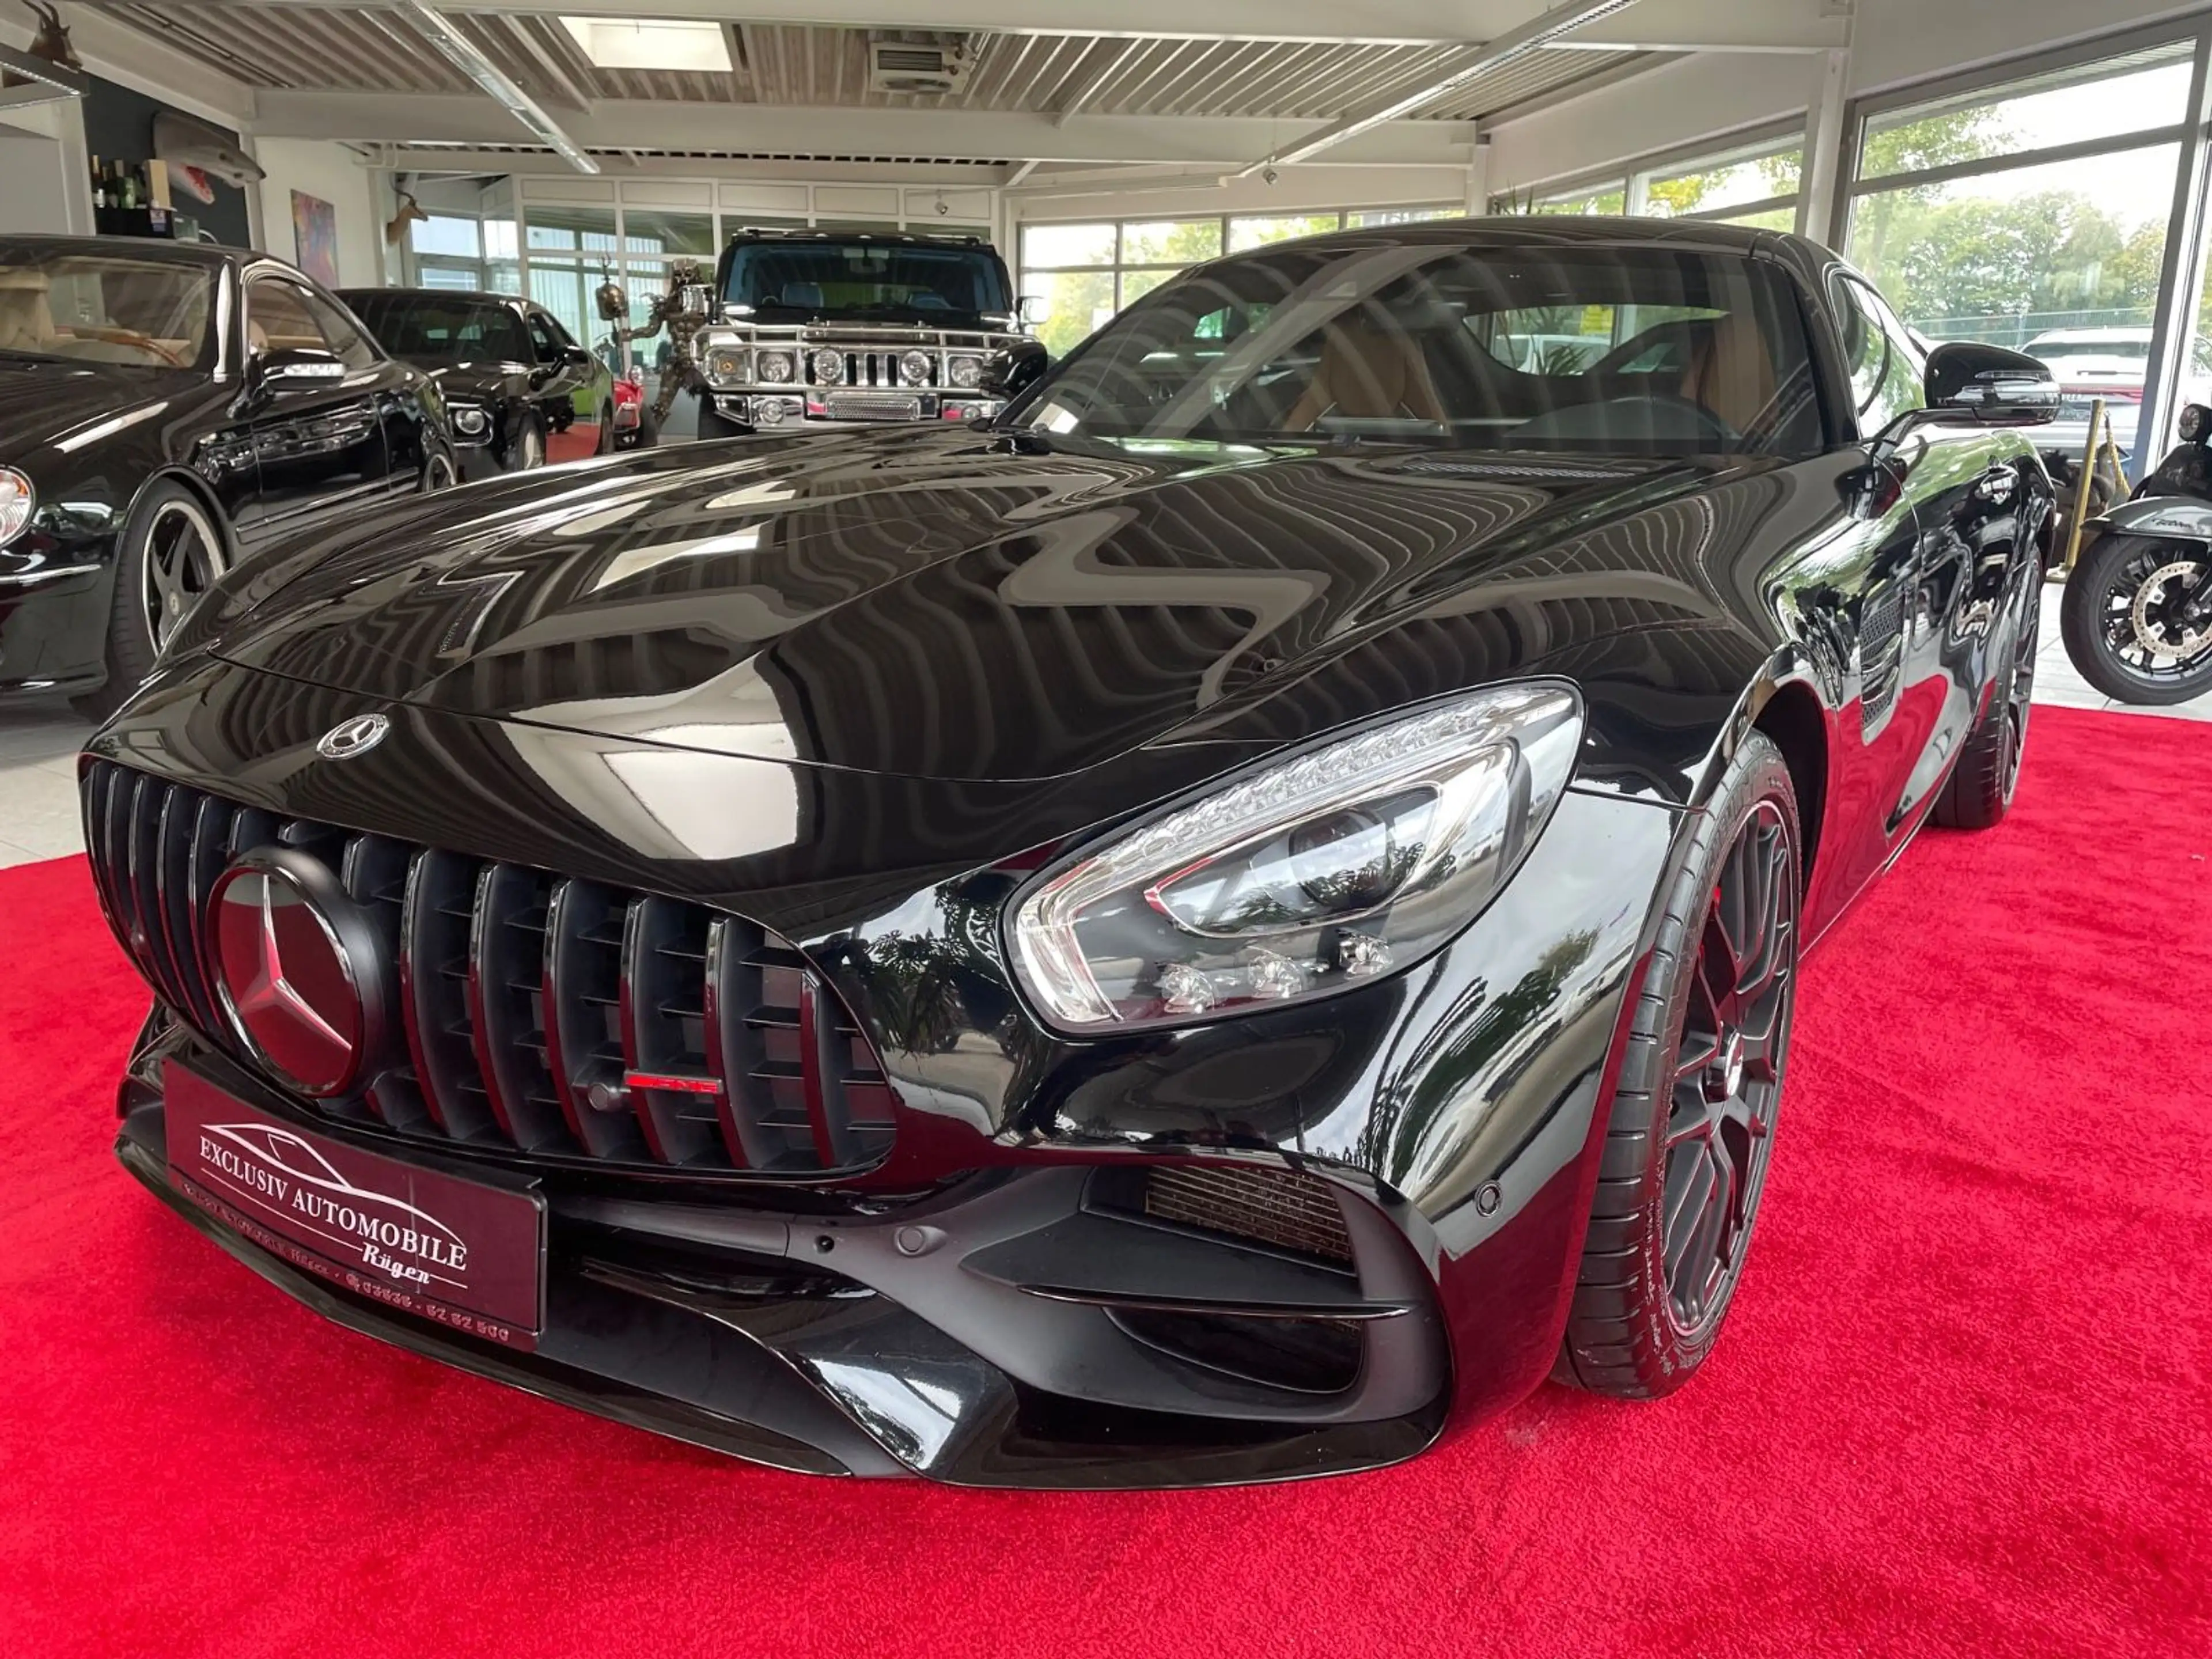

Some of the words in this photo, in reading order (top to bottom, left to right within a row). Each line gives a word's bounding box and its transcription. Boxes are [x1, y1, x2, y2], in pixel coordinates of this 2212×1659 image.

[200, 1135, 288, 1202] EXCLUSIV
[291, 1187, 467, 1271] AUTOMOBILE
[362, 1241, 430, 1284] Rügen
